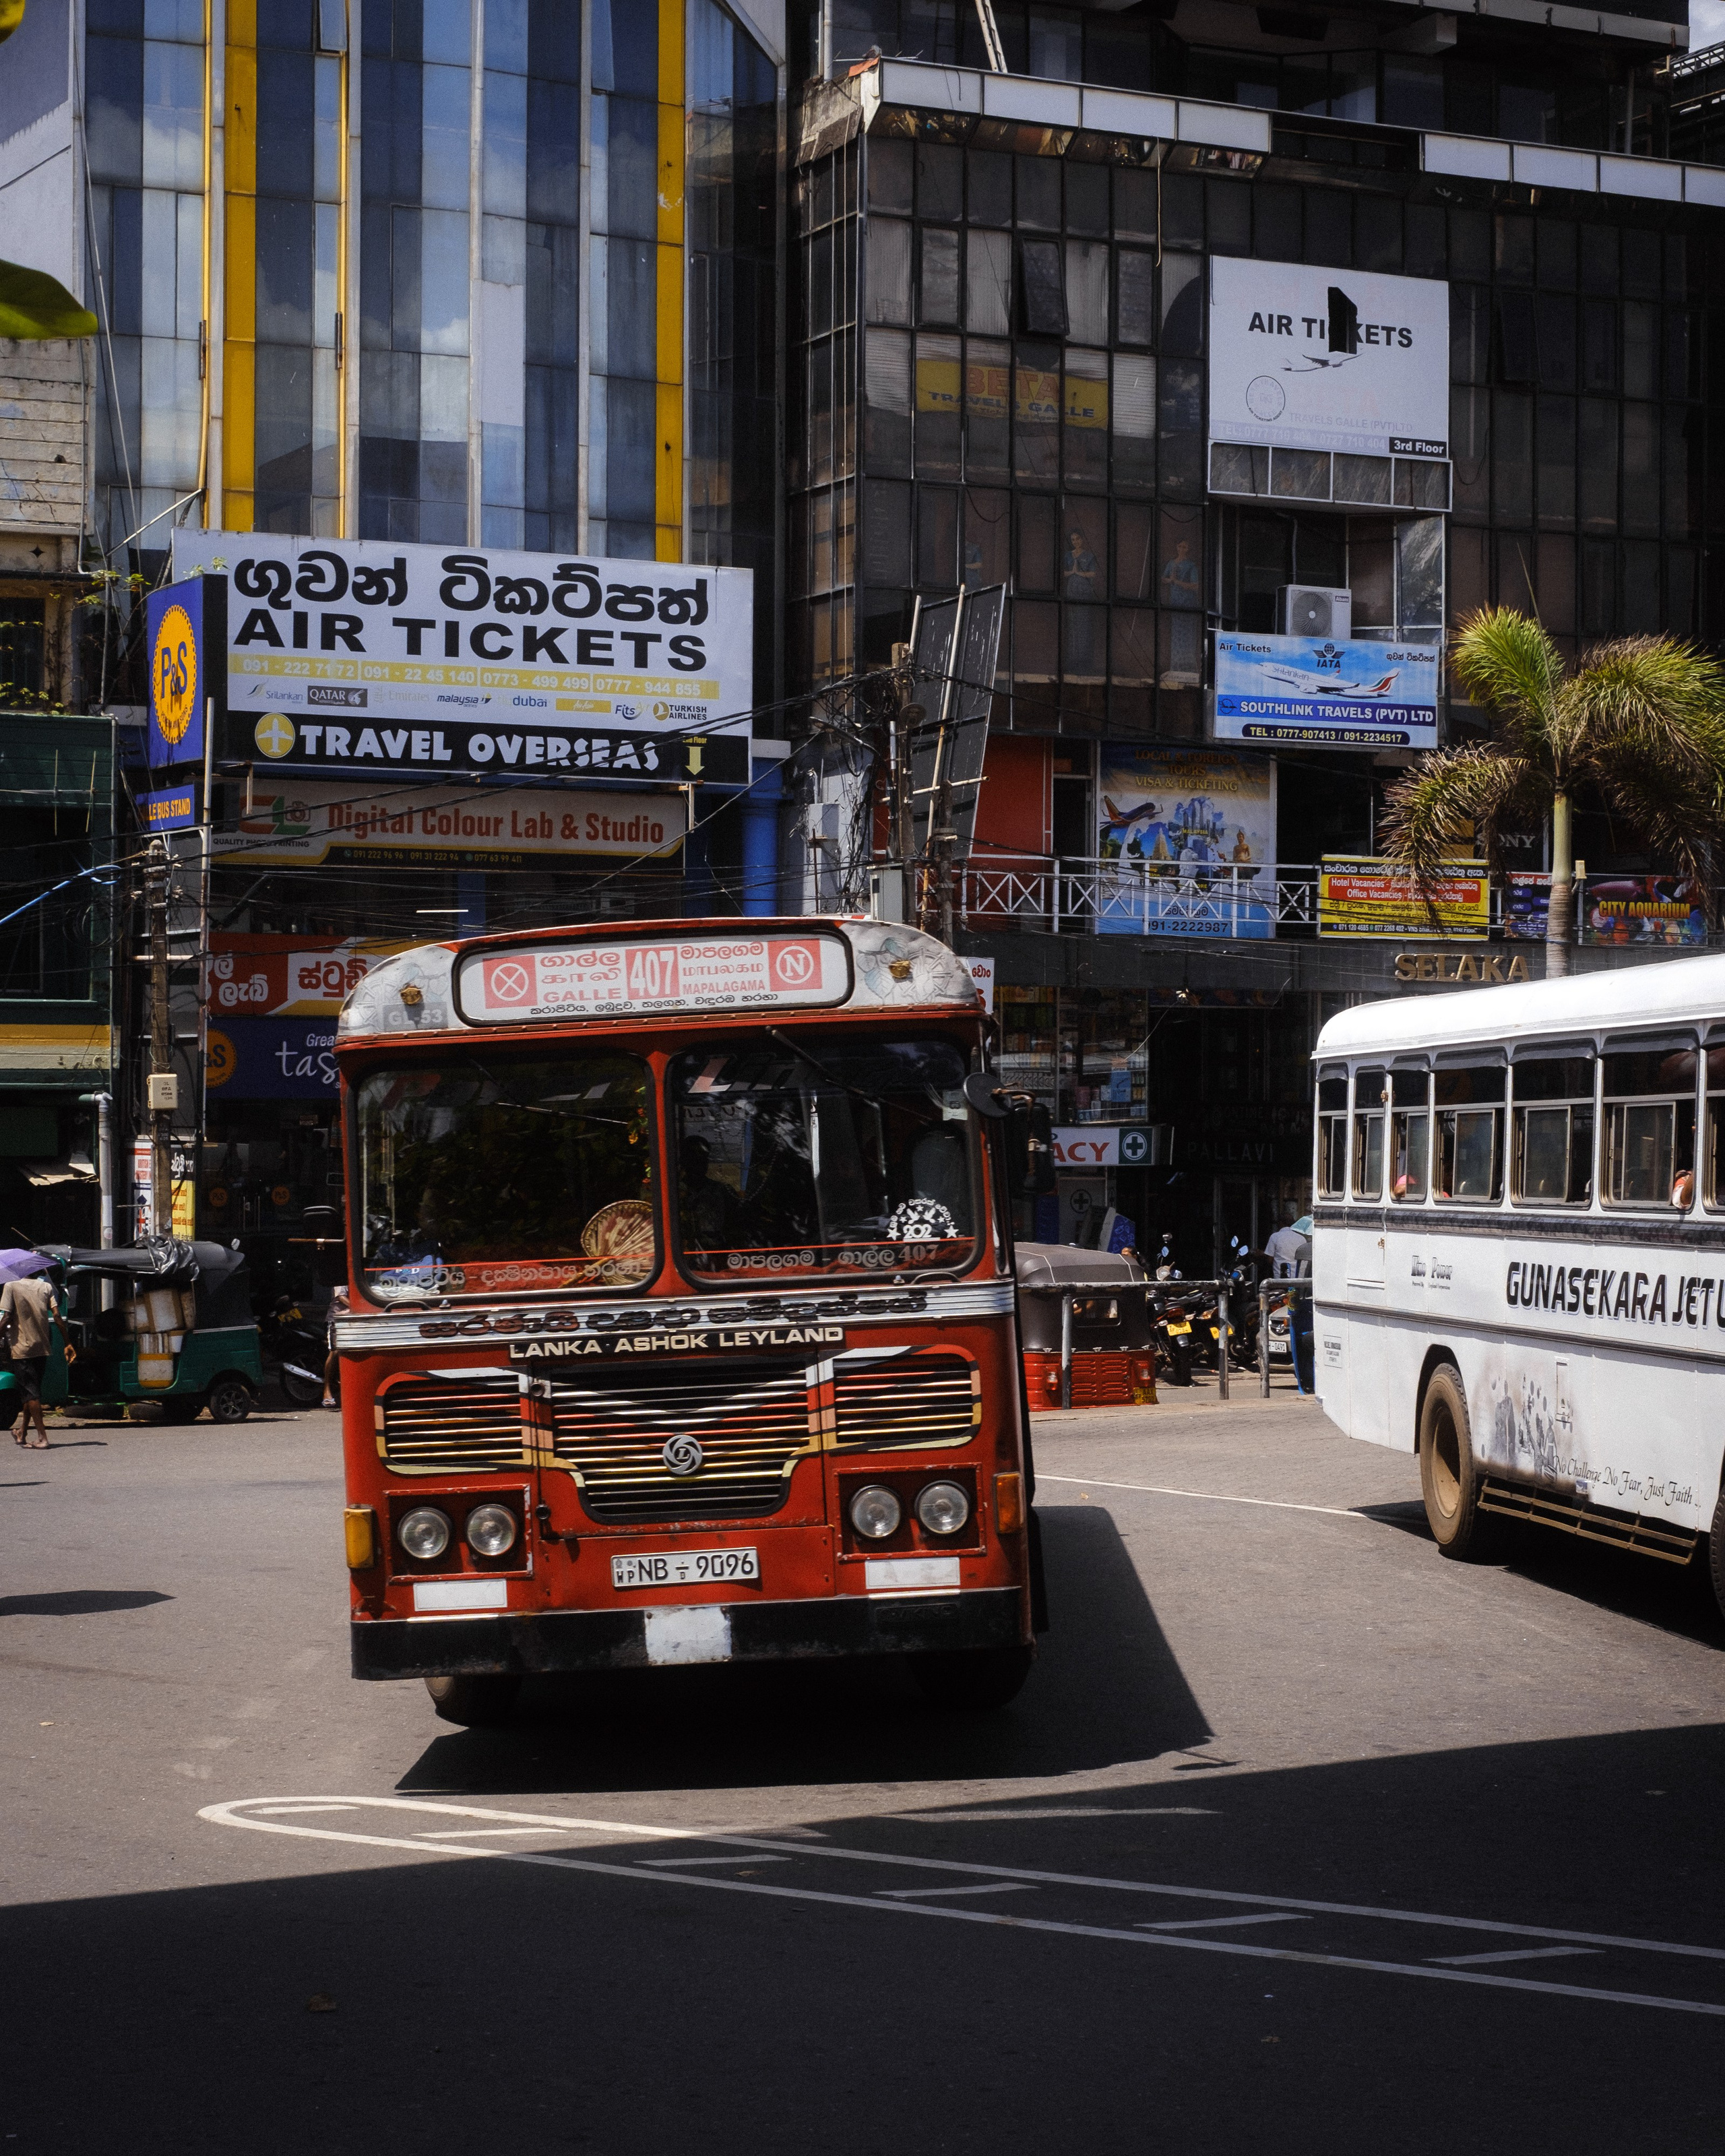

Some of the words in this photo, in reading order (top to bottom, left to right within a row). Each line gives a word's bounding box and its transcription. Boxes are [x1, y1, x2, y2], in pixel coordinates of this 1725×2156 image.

[1248, 312, 1293, 336] AIR
[1302, 317, 1413, 348] TIKETS
[966, 367, 1059, 402] BETA
[1028, 402, 1094, 418] GALE
[1289, 412, 1332, 426] TRAVELS
[1336, 414, 1368, 429] GALLE
[1394, 440, 1412, 451] 3rd
[1415, 441, 1444, 454] Floor
[234, 550, 408, 610] ගුවන්
[439, 554, 709, 625] ටිකට්පත්
[233, 608, 367, 652] AIR
[392, 617, 707, 672] TICKETS
[1219, 643, 1234, 652] Air
[1237, 643, 1272, 654] Tickets
[161, 641, 188, 699] P&S
[1317, 659, 1341, 669] IATA
[284, 661, 310, 675] 222
[364, 666, 389, 679] 091
[404, 668, 422, 681] 22
[450, 670, 475, 683] 140
[484, 672, 519, 687] 0773
[532, 674, 558, 689] 499
[563, 676, 589, 689] 499
[596, 678, 631, 692] 0777
[644, 681, 671, 695] 944
[676, 683, 701, 696] 855
[309, 689, 346, 701] QATAR
[437, 694, 479, 705] malaysia
[668, 713, 707, 721] AIRLINES
[669, 705, 707, 714] TURKISH
[1241, 701, 1313, 716] SOUTHLINK
[1317, 705, 1372, 720] TRAVELS
[1376, 709, 1408, 723] (PVT)
[1411, 710, 1434, 722] LTD
[693, 736, 708, 744] Floor
[1250, 727, 1268, 737] TEL
[1277, 728, 1336, 740] 0777-907413
[1344, 732, 1402, 743] 091-2234517
[300, 725, 452, 761] TRAVEL
[468, 734, 659, 771] OVERSEAS
[1135, 750, 1172, 761] LOCAL
[1187, 753, 1238, 765] FOREIGN
[1168, 765, 1206, 775] TOURS
[1135, 776, 1162, 787] VISA
[1165, 778, 1174, 788] &
[1179, 778, 1238, 792] TICKETING
[157, 800, 170, 818] BUS
[171, 797, 191, 817] STAND
[329, 804, 413, 839] Digital
[421, 808, 503, 838] Colour
[511, 810, 553, 839] Lab
[561, 813, 579, 840] &
[586, 813, 664, 844] Studio
[1331, 878, 1350, 887] Hotel
[1351, 879, 1385, 888] Vacancies
[1347, 889, 1367, 898] Office
[1369, 890, 1402, 899] Vacancies
[1599, 901, 1626, 917] CITY
[1629, 901, 1691, 918] AQUARIUM
[1146, 920, 1228, 933] 91-2222987
[681, 941, 764, 960] මාපලගම
[540, 951, 621, 968] ගාල්ල
[784, 953, 806, 977] N
[1394, 953, 1530, 982] SELAKA
[541, 967, 621, 984] காலி
[630, 949, 675, 997] 407
[543, 988, 622, 1003] GALLE
[682, 980, 765, 995] MAPALAGAMA
[389, 1009, 443, 1025] GL-53
[307, 1033, 336, 1047] Grea
[207, 1044, 226, 1068] &S
[275, 1041, 340, 1085] tas
[1053, 1141, 1110, 1162] ACY
[1187, 1141, 1274, 1162] PALLAVI
[903, 1224, 933, 1238] 202
[727, 1250, 815, 1271] මාපලගම
[838, 1248, 895, 1268] ගාල්ල
[898, 1244, 939, 1262] 407
[1506, 1261, 1667, 1325] GUNASEKARA
[509, 1339, 602, 1360] LANKA
[614, 1333, 708, 1354] ASHOK
[719, 1327, 843, 1348] LEYLAND
[676, 1448, 690, 1460] L
[1554, 1455, 1566, 1474] No
[1567, 1457, 1602, 1484] Challenge
[1602, 1466, 1619, 1486] No
[1619, 1471, 1643, 1496] Fear,
[1643, 1476, 1665, 1501] Just
[1665, 1480, 1693, 1507] Faith
[638, 1557, 668, 1582] NB
[696, 1552, 754, 1579] 9096
